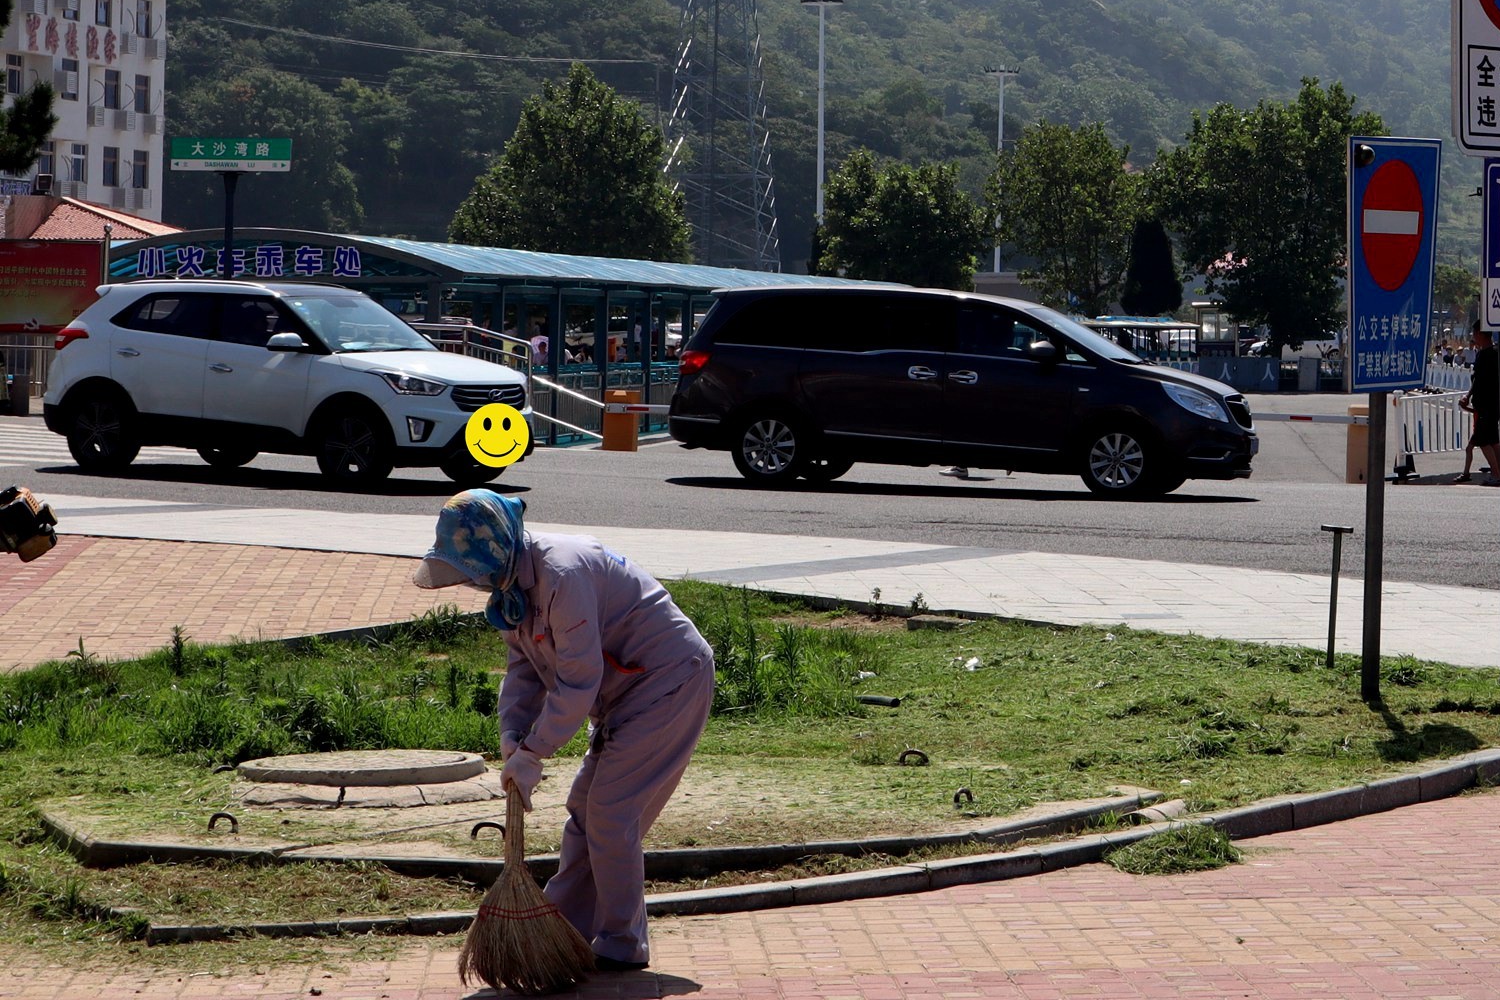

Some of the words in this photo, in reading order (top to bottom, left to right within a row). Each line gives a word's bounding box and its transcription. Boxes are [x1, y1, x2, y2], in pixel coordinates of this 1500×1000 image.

[191, 141, 270, 157] 大沙湾路
[137, 245, 361, 278] 小火车乘车处
[1358, 313, 1421, 341] 公交车停车场
[1357, 349, 1420, 378] 严禁其他车辆进入
